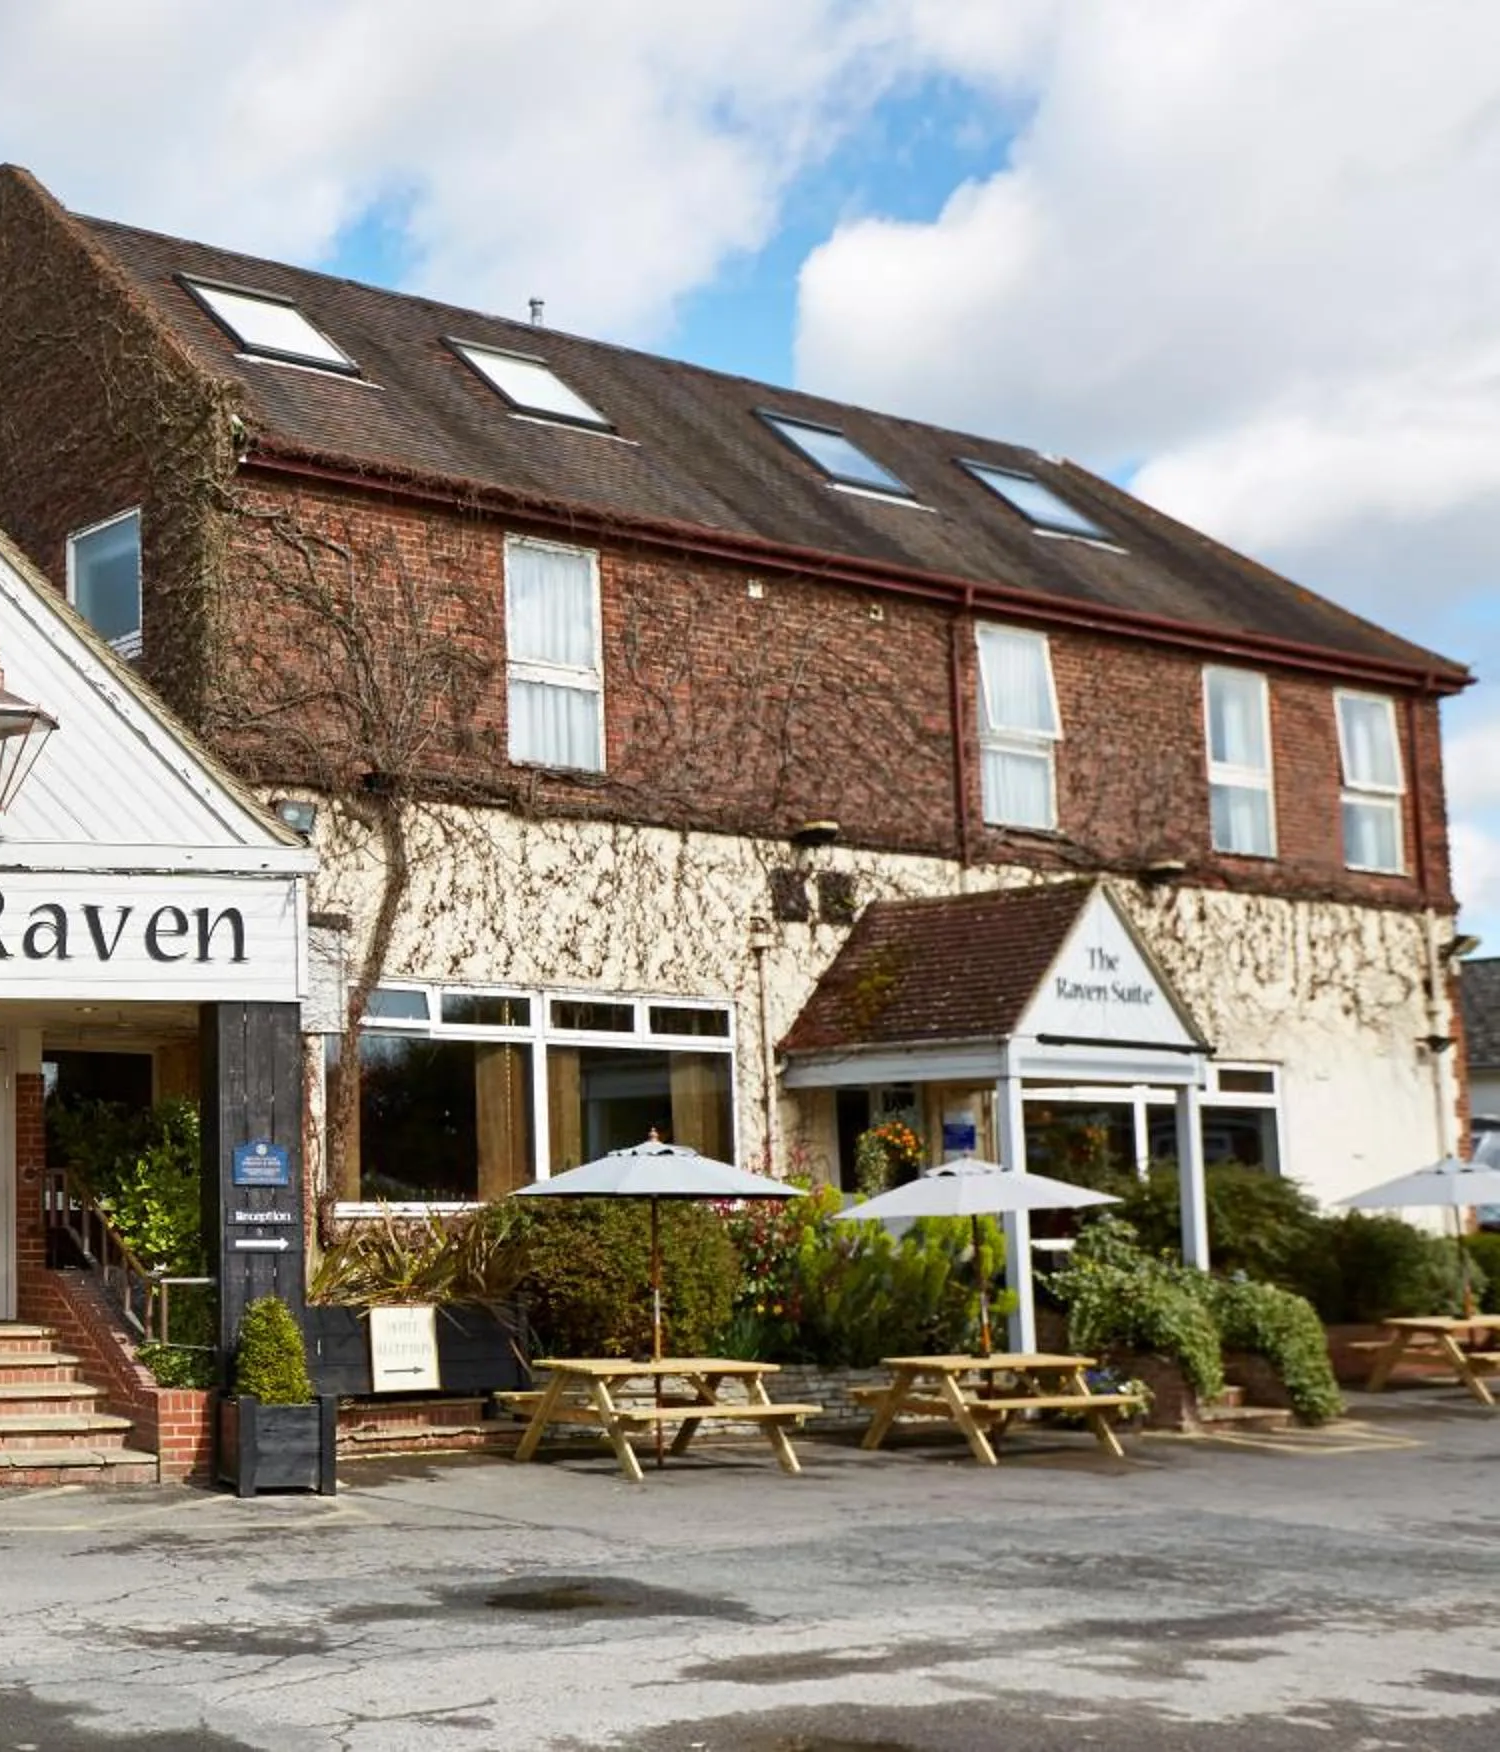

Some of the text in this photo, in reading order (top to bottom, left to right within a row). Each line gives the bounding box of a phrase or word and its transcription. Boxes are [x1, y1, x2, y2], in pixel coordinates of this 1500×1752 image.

[1087, 947, 1120, 971] The
[1055, 977, 1154, 1005] Raven Suite
[235, 1209, 291, 1223] Reception
